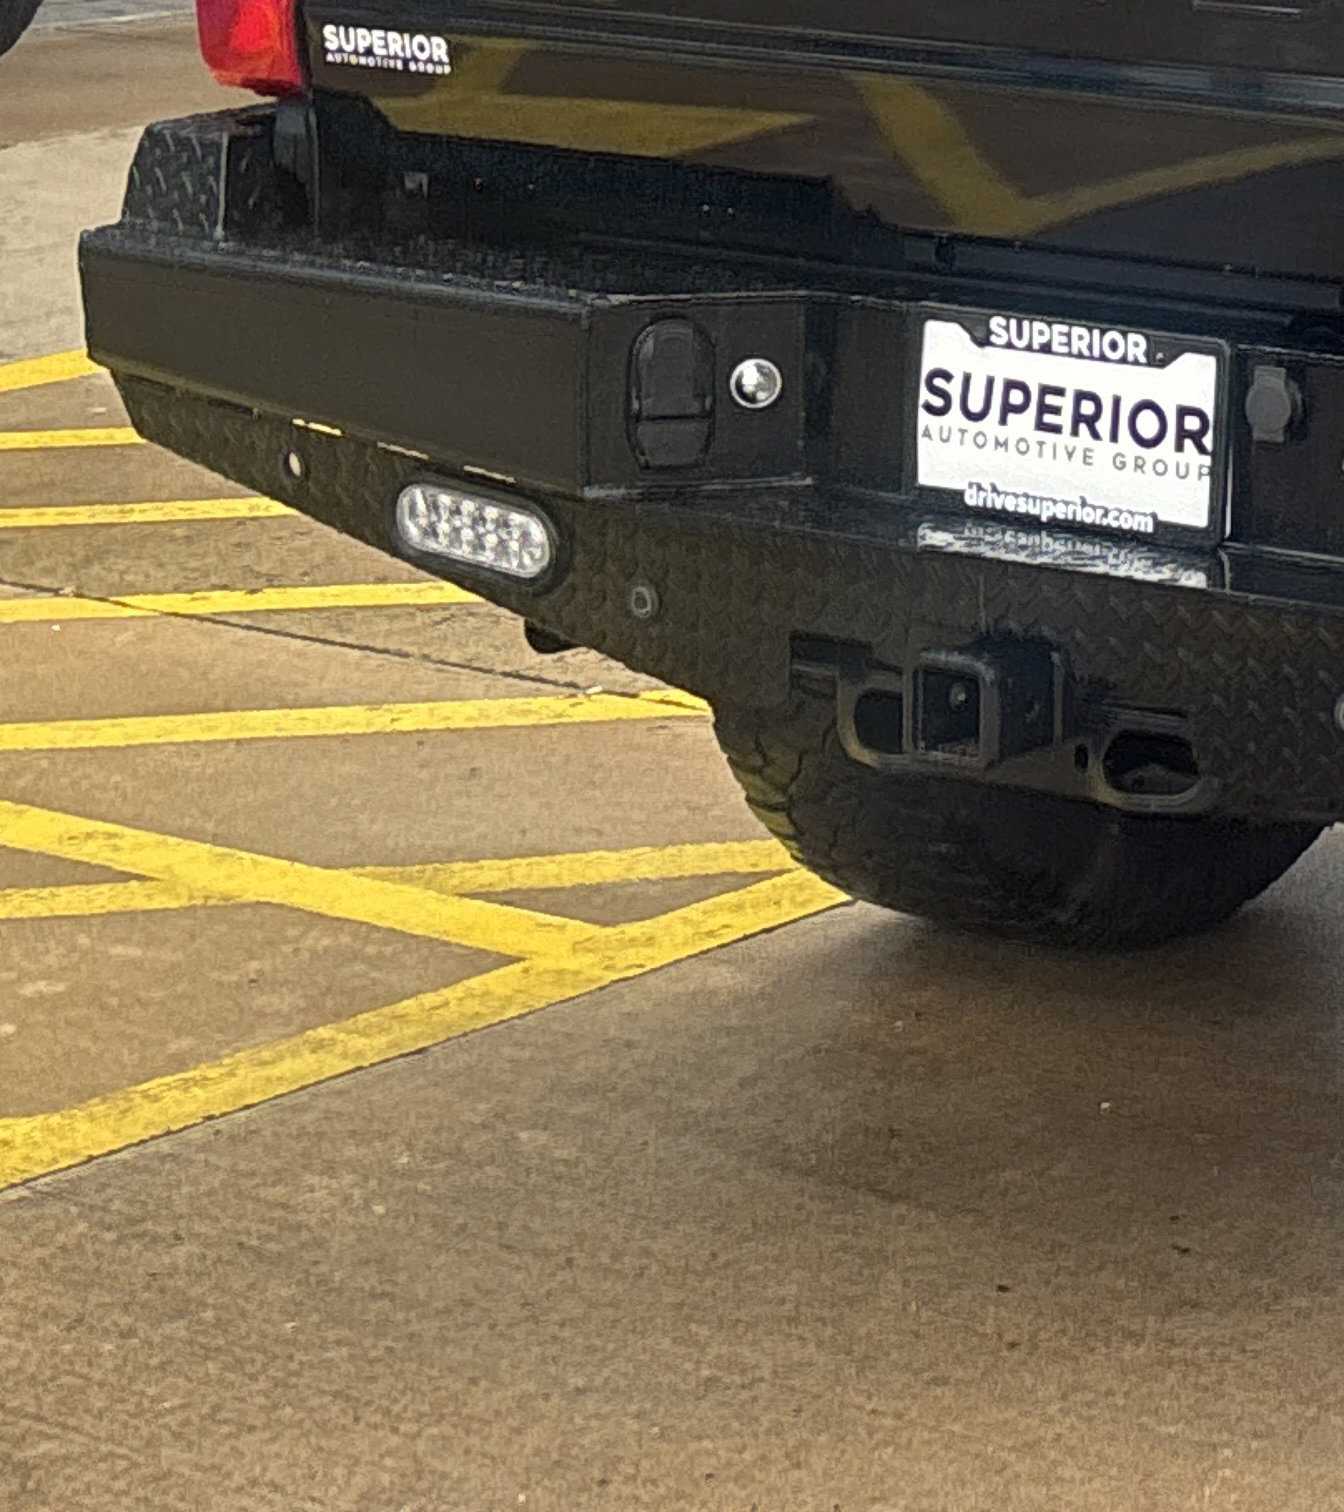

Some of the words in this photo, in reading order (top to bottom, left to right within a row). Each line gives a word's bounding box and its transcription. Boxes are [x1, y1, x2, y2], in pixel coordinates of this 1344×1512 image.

[322, 24, 450, 63] SUPERIOR
[326, 52, 403, 71] AUTOMOTIVE
[988, 315, 1149, 364] SUPERIOR
[921, 367, 1213, 457] SUPERIOR
[921, 423, 1095, 467] AUTOMOTIVE
[1111, 452, 1211, 482] GROUP
[963, 481, 1155, 534] drivesuperior.com
